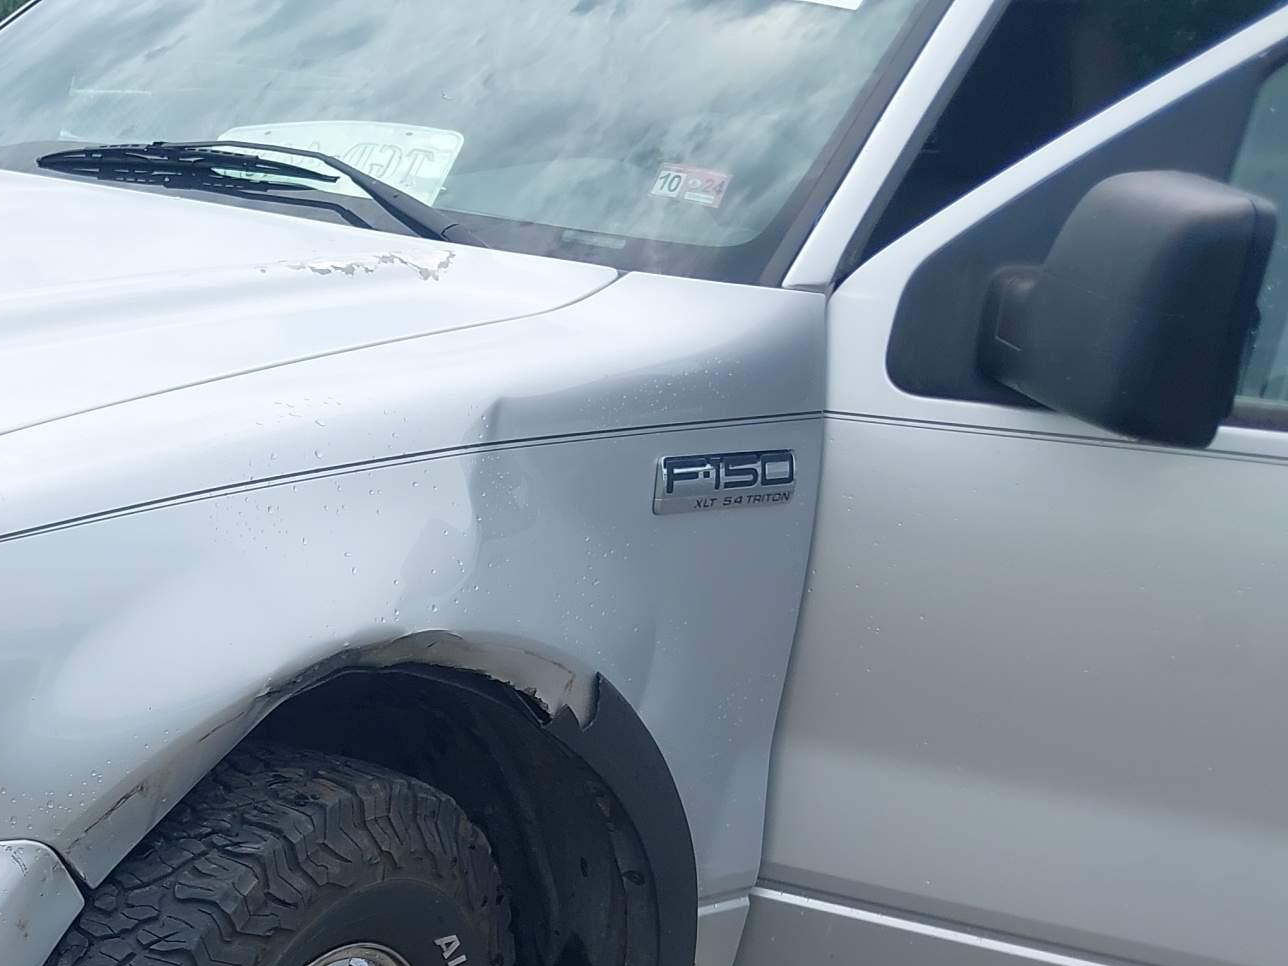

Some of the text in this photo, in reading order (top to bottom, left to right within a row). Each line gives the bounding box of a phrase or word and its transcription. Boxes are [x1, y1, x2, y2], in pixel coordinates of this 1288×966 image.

[658, 172, 682, 194] 10
[665, 453, 794, 494] F-150
[694, 497, 718, 509] XLT
[746, 491, 791, 505] TRITON
